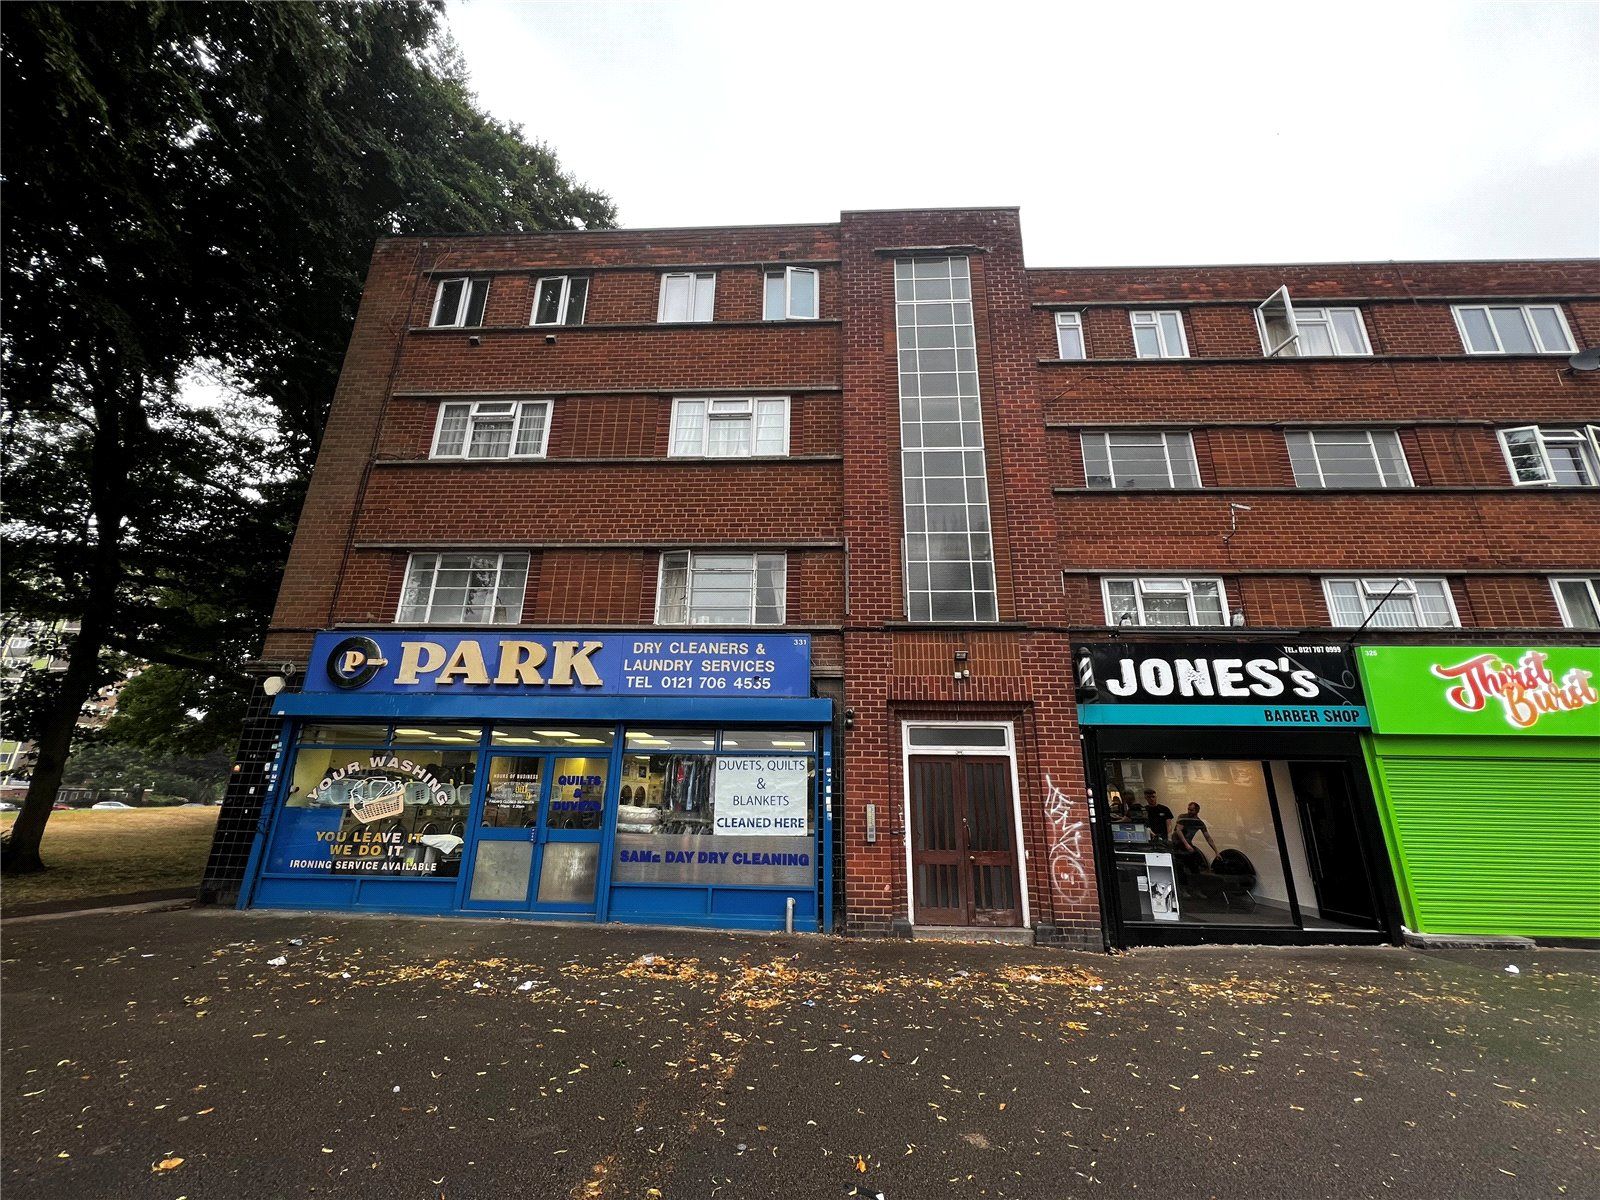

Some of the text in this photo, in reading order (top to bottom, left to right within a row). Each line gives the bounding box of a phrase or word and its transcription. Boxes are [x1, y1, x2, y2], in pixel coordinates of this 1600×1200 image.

[633, 642, 766, 655] DRY CLEANERS &
[394, 640, 604, 686] PARK
[623, 659, 775, 672] LAUNDRY SERVICES
[626, 676, 653, 688] TEL
[661, 676, 693, 689] 0121
[699, 677, 726, 689] 706
[1430, 649, 1553, 712] Thirst
[1501, 668, 1598, 728] Burst
[1264, 709, 1359, 722] BARBER SHOP
[718, 760, 806, 771] DUVETS, QUILTS
[306, 756, 449, 806] YOUR WASHING
[558, 775, 602, 786] QUILTS
[756, 778, 766, 789] &
[733, 795, 790, 806] BLANKETS
[716, 817, 805, 828] CLEANED HERE
[316, 831, 424, 844] YOU LEAVE IT
[330, 845, 404, 857] WE DO IT
[665, 851, 696, 864] DAY
[697, 851, 729, 865] DRY
[732, 852, 810, 866] CLEANING
[289, 860, 437, 872] IRONING SERVICE AVAILABLE
